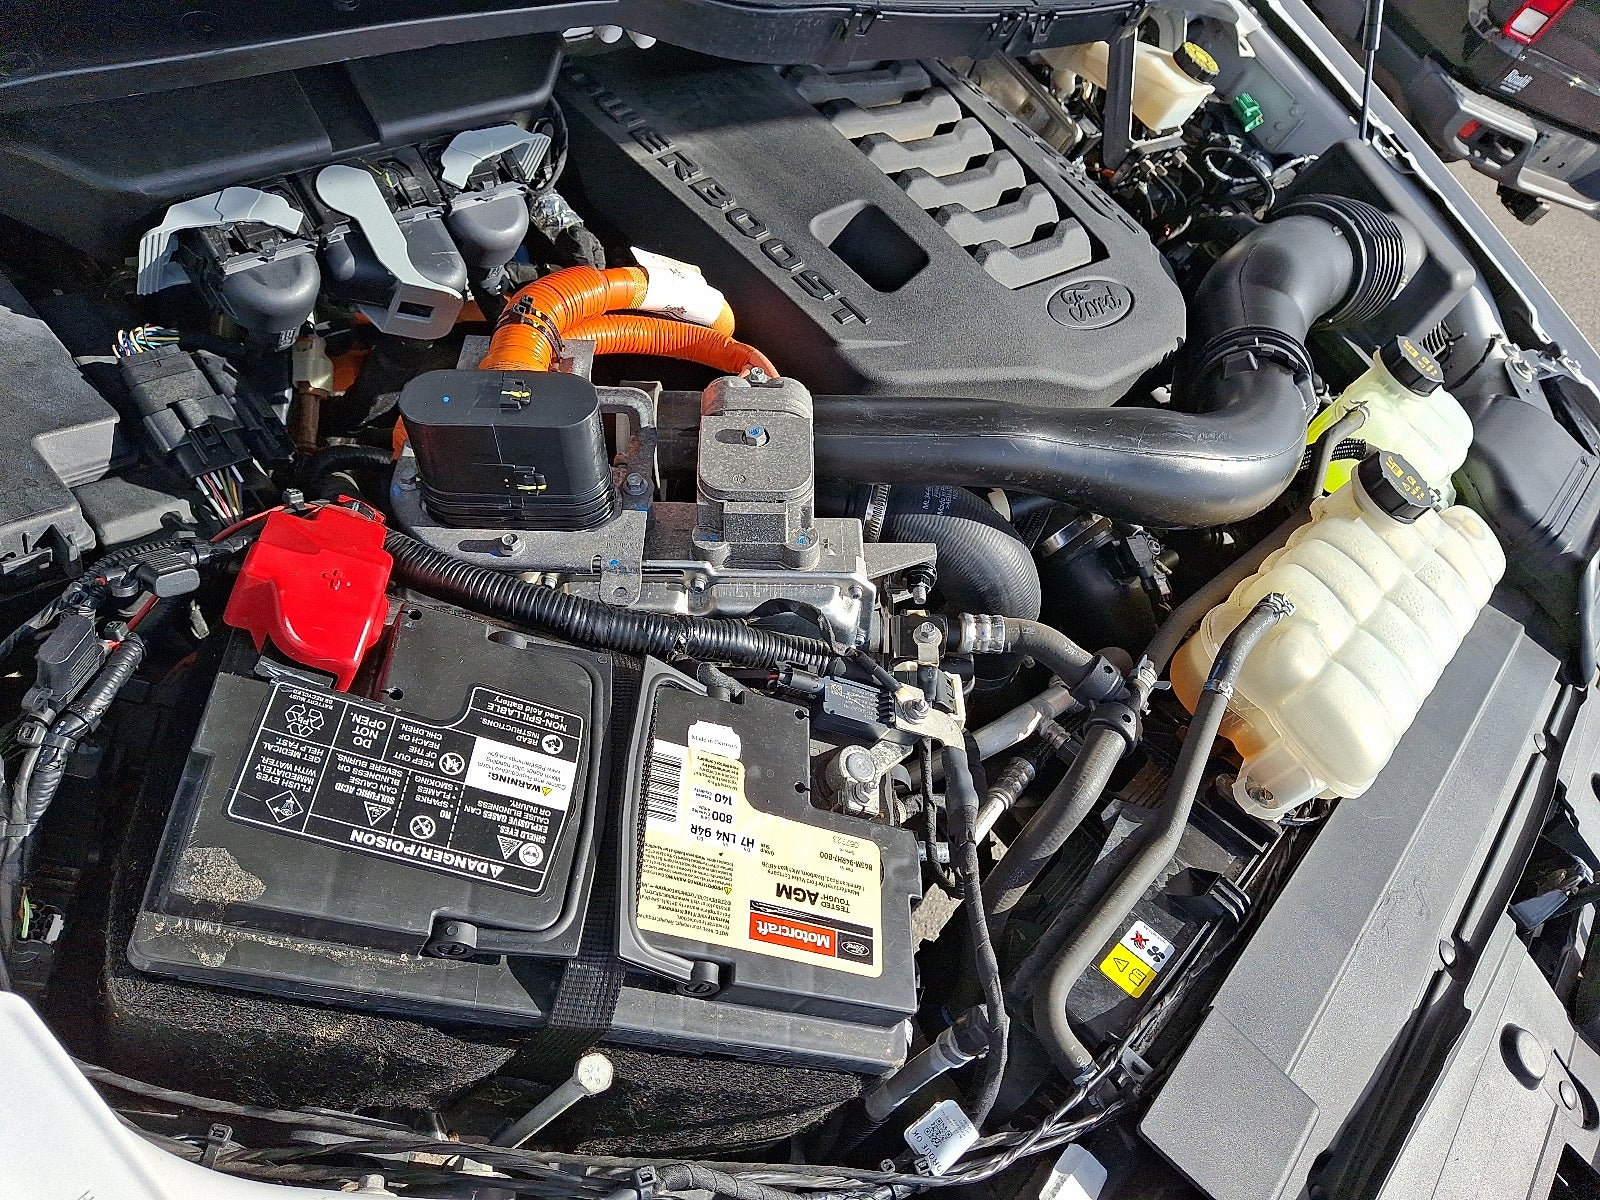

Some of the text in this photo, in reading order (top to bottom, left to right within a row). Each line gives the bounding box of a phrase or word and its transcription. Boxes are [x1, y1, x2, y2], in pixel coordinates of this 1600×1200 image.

[560, 62, 869, 325] OWERBOOST
[1060, 283, 1122, 323] Ford
[485, 701, 568, 731] NON-SPILLABLE
[493, 694, 564, 722] Lead Acid Battery
[297, 715, 309, 725] Pb
[348, 711, 387, 730] OPEN.
[478, 716, 540, 740] INSTRUCTIONS.
[351, 723, 379, 739] NOT
[397, 731, 440, 750] REACH OF
[398, 722, 443, 741] CHILDREN.
[515, 733, 538, 746] READ
[260, 740, 321, 763] GET MEDICAL
[274, 736, 324, 756] HELP FAST.
[352, 735, 372, 748] DO
[407, 744, 437, 759] OF THE
[259, 754, 317, 776] WITH WATER.
[334, 752, 403, 777] SEVERE BURNS.
[392, 750, 435, 768] KEEP OUT
[254, 762, 315, 784] IMMEDIATELY
[254, 771, 311, 792] FLUSH EYES
[336, 763, 400, 786] BLINDNESS OR
[413, 773, 453, 791] SMOKING
[486, 770, 542, 793] WARNING:
[334, 781, 395, 804] SULFURIC ACID
[348, 775, 398, 794] CAN CAUSE
[416, 784, 451, 800] FLAMES
[414, 792, 448, 809] SPARKS
[508, 798, 551, 817] OR INJURY.
[713, 792, 733, 805] 140
[463, 804, 548, 833] EXPLOSIVE GASES CAN
[476, 798, 550, 825] CAUSE BLINDNESS
[710, 810, 732, 824] 800
[496, 823, 546, 843] SHIELD EYES.
[689, 823, 755, 848] H7 LN4 94R
[349, 829, 488, 874] DANGER/POISON
[773, 880, 819, 906] AGM
[820, 899, 850, 913] TESTED
[754, 919, 830, 948] Motorcraft
[911, 1129, 923, 1142] OK
